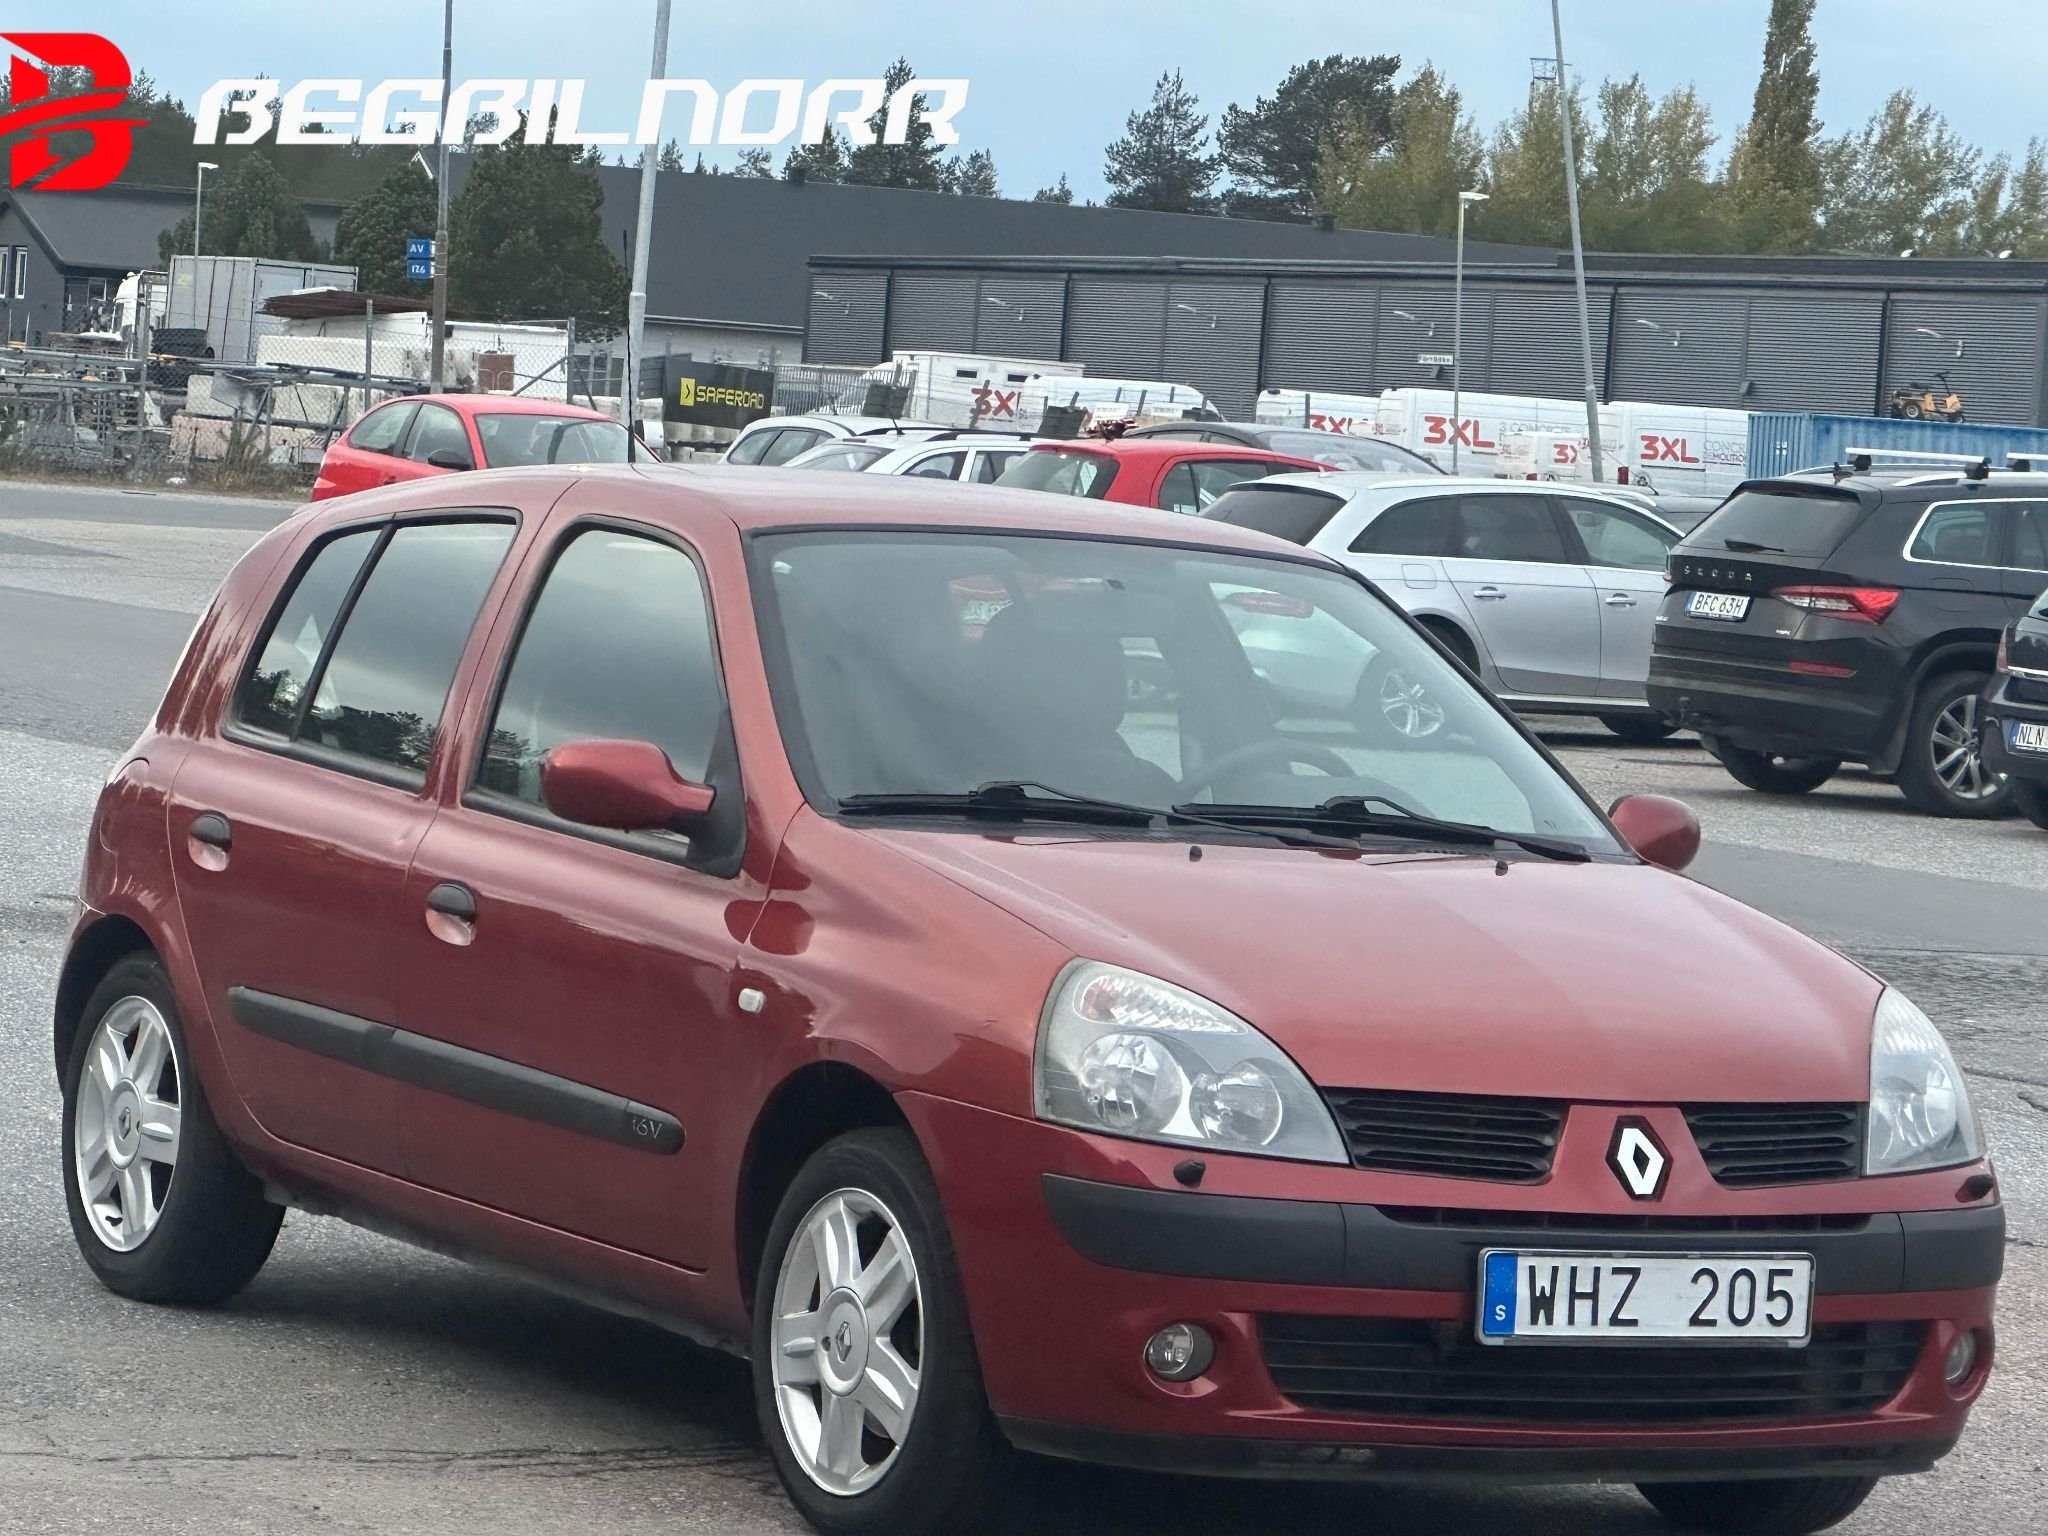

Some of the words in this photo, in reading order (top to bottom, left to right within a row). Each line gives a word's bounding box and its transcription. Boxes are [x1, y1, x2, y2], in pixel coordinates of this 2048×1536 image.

[696, 386, 764, 410] SAFEROAD
[971, 387, 1021, 418] 3X
[1424, 416, 1495, 448] 3XL
[1641, 435, 1700, 463] 3XL
[1695, 594, 1719, 611] BFC
[1719, 597, 1744, 614] 63H
[1529, 1265, 1641, 1327] WHZ
[1689, 1267, 1793, 1327] 205
[1495, 1304, 1506, 1321] S
